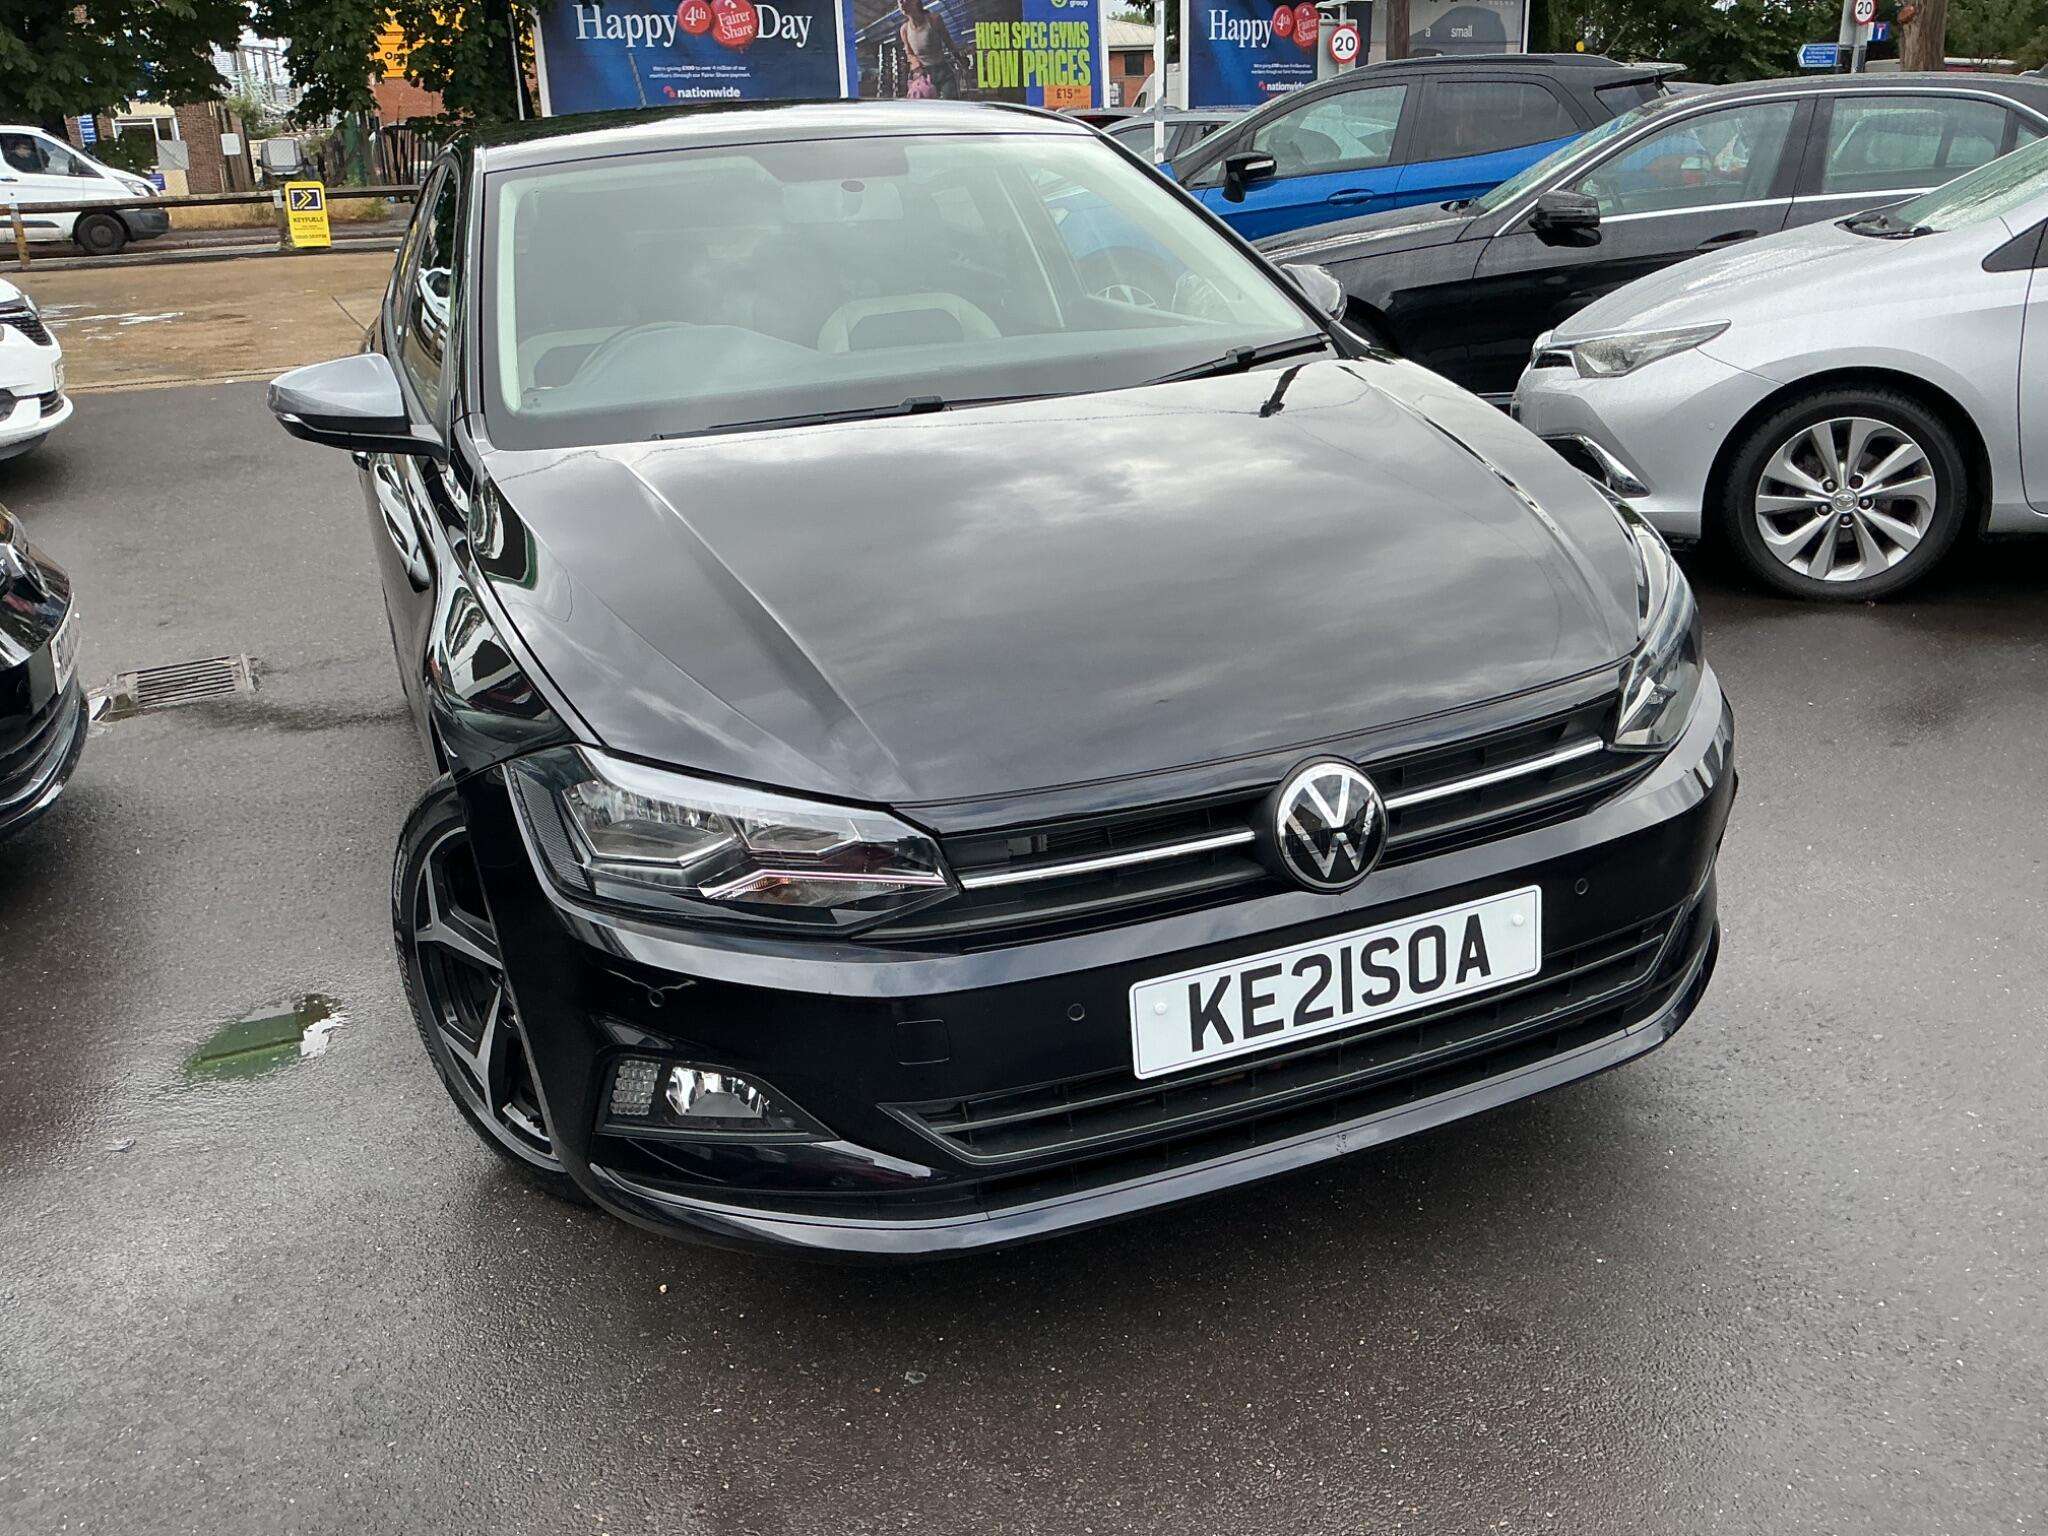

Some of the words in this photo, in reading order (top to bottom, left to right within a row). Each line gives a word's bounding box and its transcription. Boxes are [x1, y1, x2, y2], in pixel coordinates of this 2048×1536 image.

[685, 6, 706, 26] 4th
[1857, 2, 1872, 15] 20
[573, 5, 678, 47] Happy
[718, 11, 751, 26] Fairer
[754, 4, 813, 48] Day
[722, 24, 753, 40] Share
[975, 22, 1010, 49] HIGH
[1011, 22, 1047, 49] SPEC
[1049, 21, 1089, 48] GYMS
[1208, 9, 1273, 48] Happy
[1425, 27, 1431, 38] a
[1451, 25, 1473, 38] small
[1334, 36, 1356, 51] 20
[977, 50, 1018, 88] LOW
[1022, 49, 1090, 87] PRICES
[677, 86, 741, 98] nationwide
